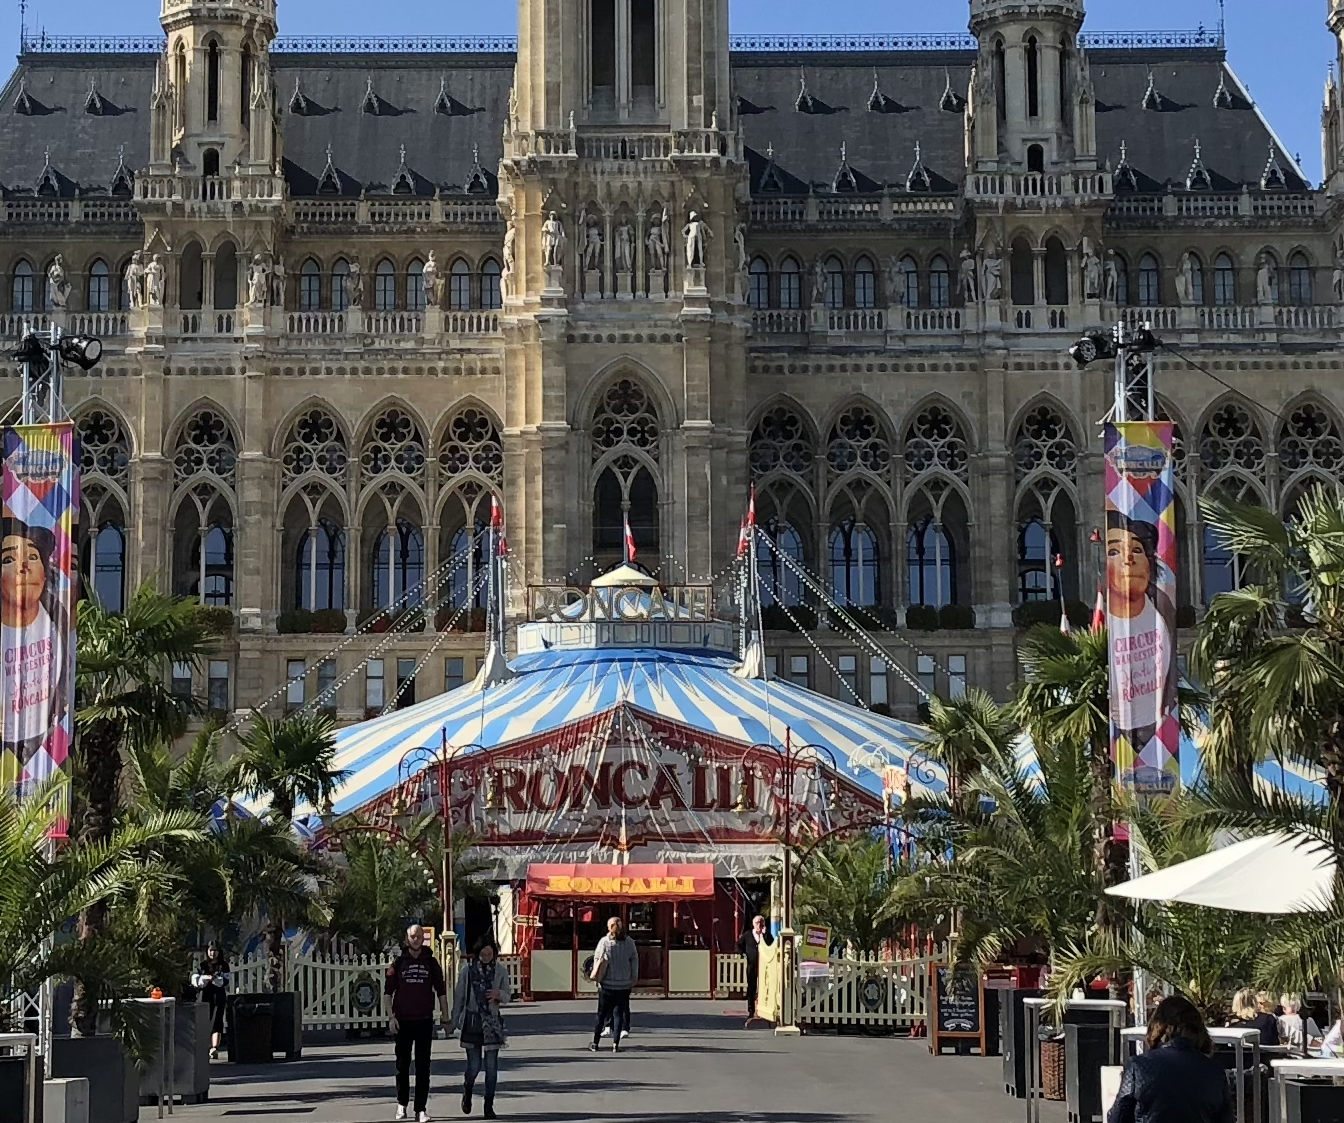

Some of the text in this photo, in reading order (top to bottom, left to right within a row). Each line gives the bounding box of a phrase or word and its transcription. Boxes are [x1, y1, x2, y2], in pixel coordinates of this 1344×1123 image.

[528, 586, 713, 623] RONCALLI
[494, 759, 757, 814] RONCALLI
[546, 875, 696, 895] RONCALLI
